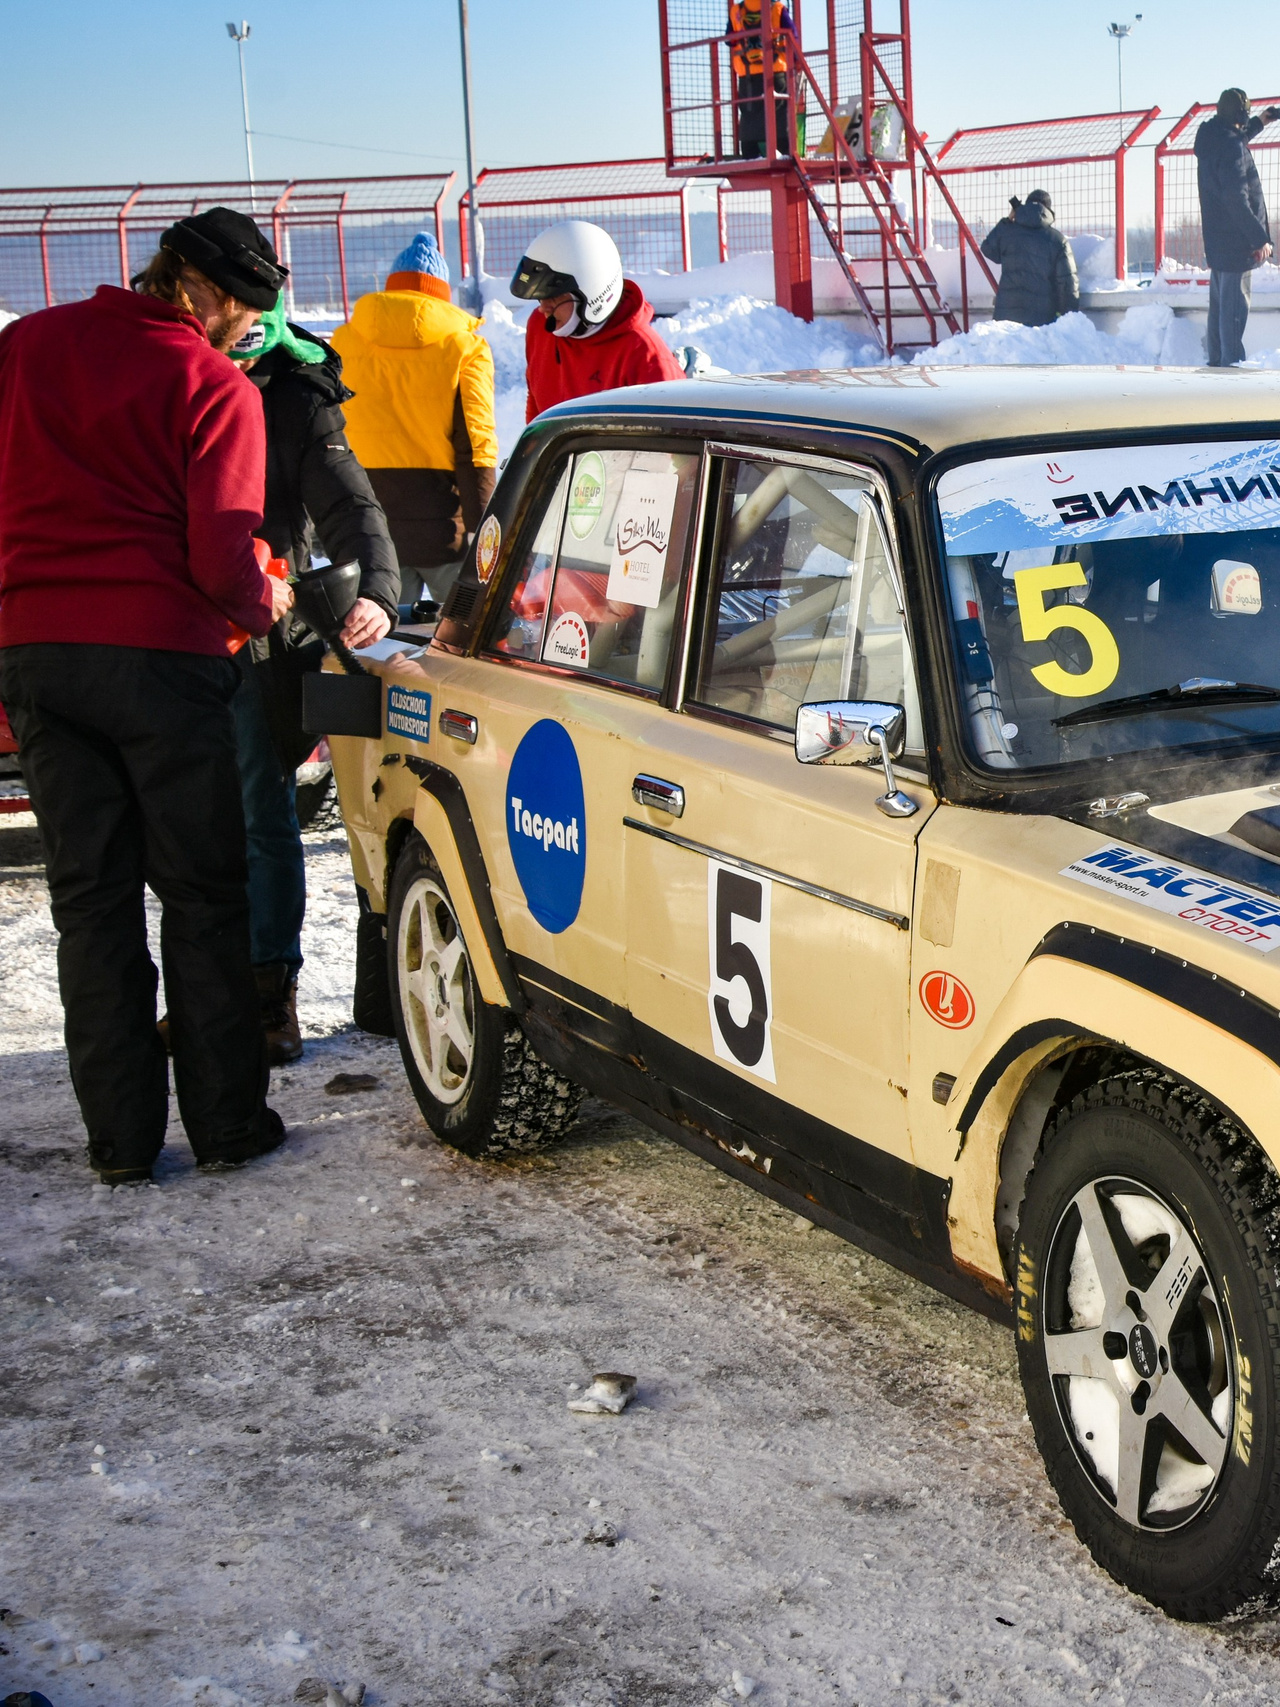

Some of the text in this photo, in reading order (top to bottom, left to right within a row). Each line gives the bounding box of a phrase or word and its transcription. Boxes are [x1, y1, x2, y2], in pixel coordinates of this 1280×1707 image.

[629, 560, 650, 574] HOTEL
[1014, 562, 1119, 697] 5
[555, 641, 579, 659] FreeLogic
[391, 691, 427, 716] OLDSCHOOL
[388, 711, 428, 738] MOTORSPORT
[1068, 863, 1150, 898] www.master-sport.ru
[1177, 907, 1272, 943] СПОРТ
[714, 868, 768, 1067] 5
